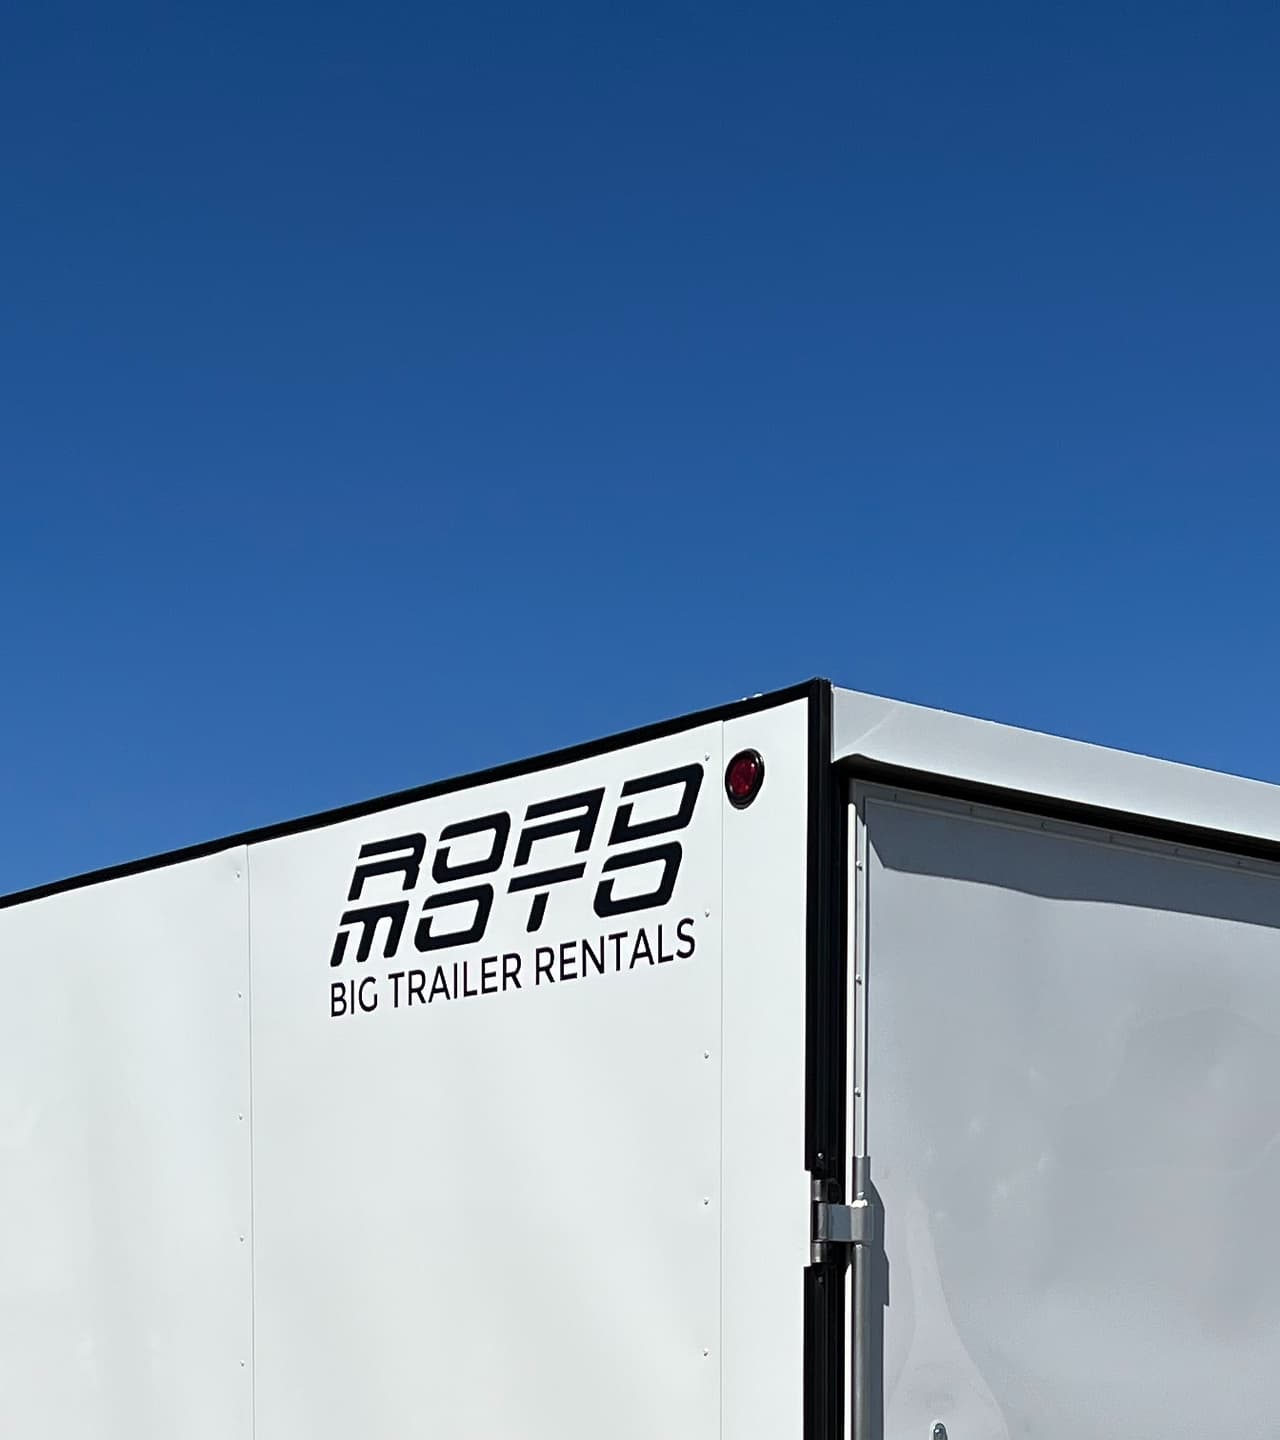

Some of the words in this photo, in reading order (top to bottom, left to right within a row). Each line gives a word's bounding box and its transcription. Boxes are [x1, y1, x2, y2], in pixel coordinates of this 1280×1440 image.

[348, 763, 705, 902] ROAD
[329, 841, 683, 967] MOTO
[331, 976, 378, 1018] BIG
[388, 952, 522, 1009] TRAILER
[535, 917, 697, 986] RENTALS
